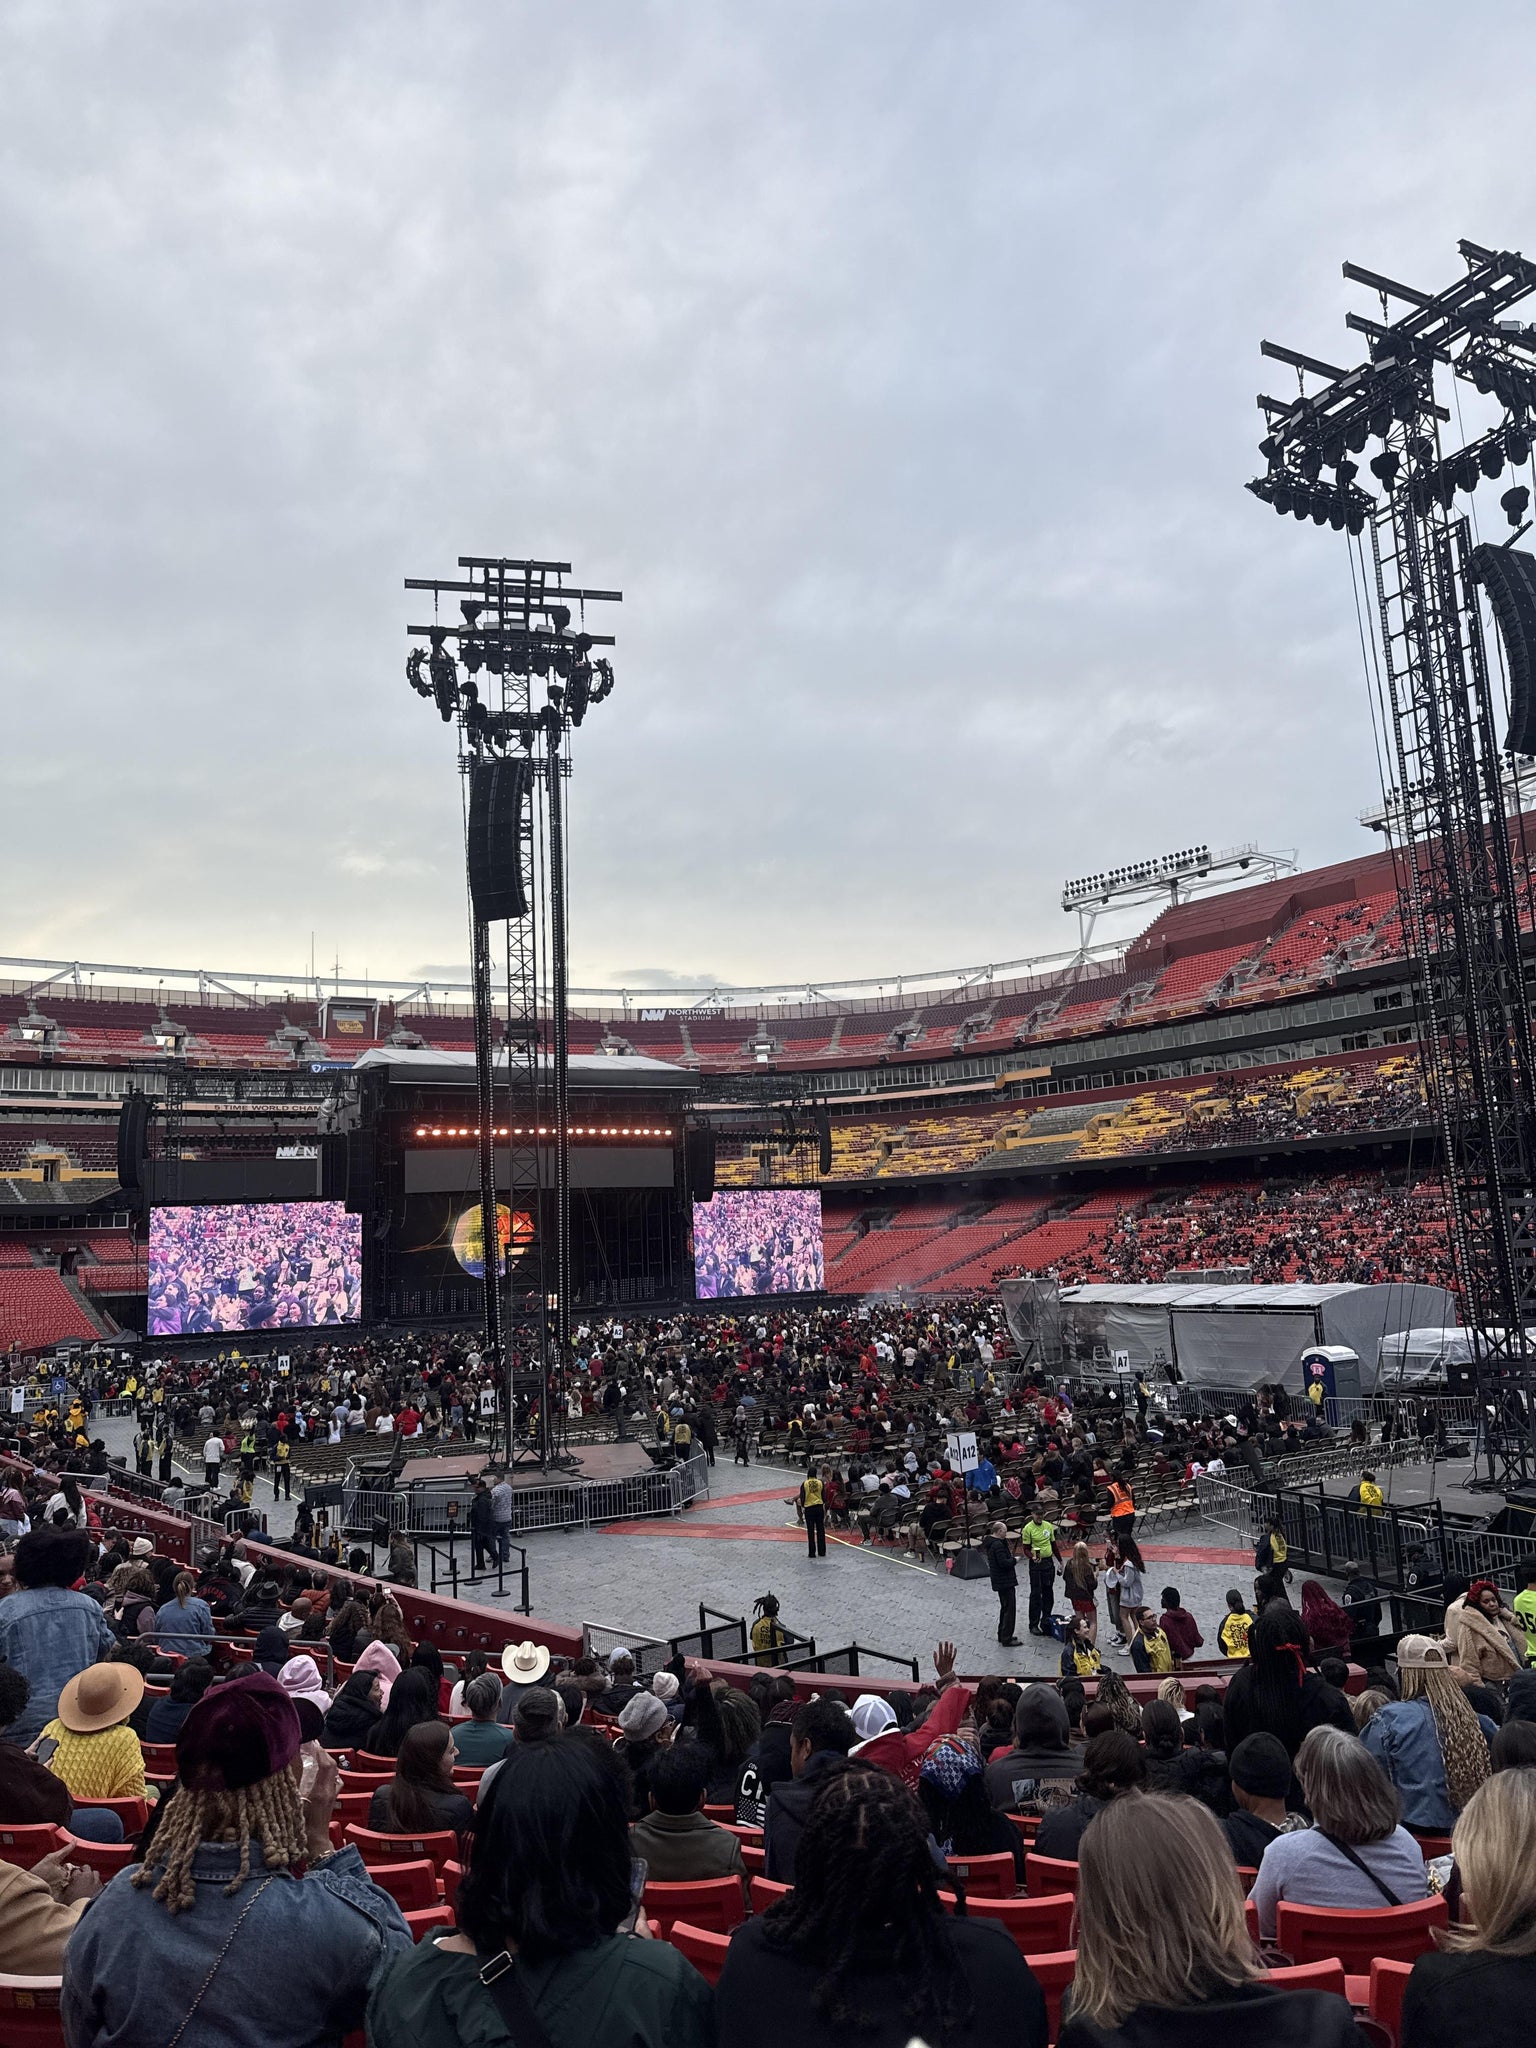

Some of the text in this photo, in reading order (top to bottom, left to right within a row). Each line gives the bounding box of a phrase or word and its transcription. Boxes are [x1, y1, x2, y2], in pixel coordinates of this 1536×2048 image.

[641, 1009, 667, 1021] NW
[276, 1146, 298, 1157] NW
[279, 1359, 288, 1367] A1
[1117, 1356, 1128, 1367] A7
[962, 1445, 976, 1460] A12
[1229, 1622, 1248, 1633] CSC
[1514, 1611, 1536, 1634] 35
[760, 1625, 771, 1633] CS
